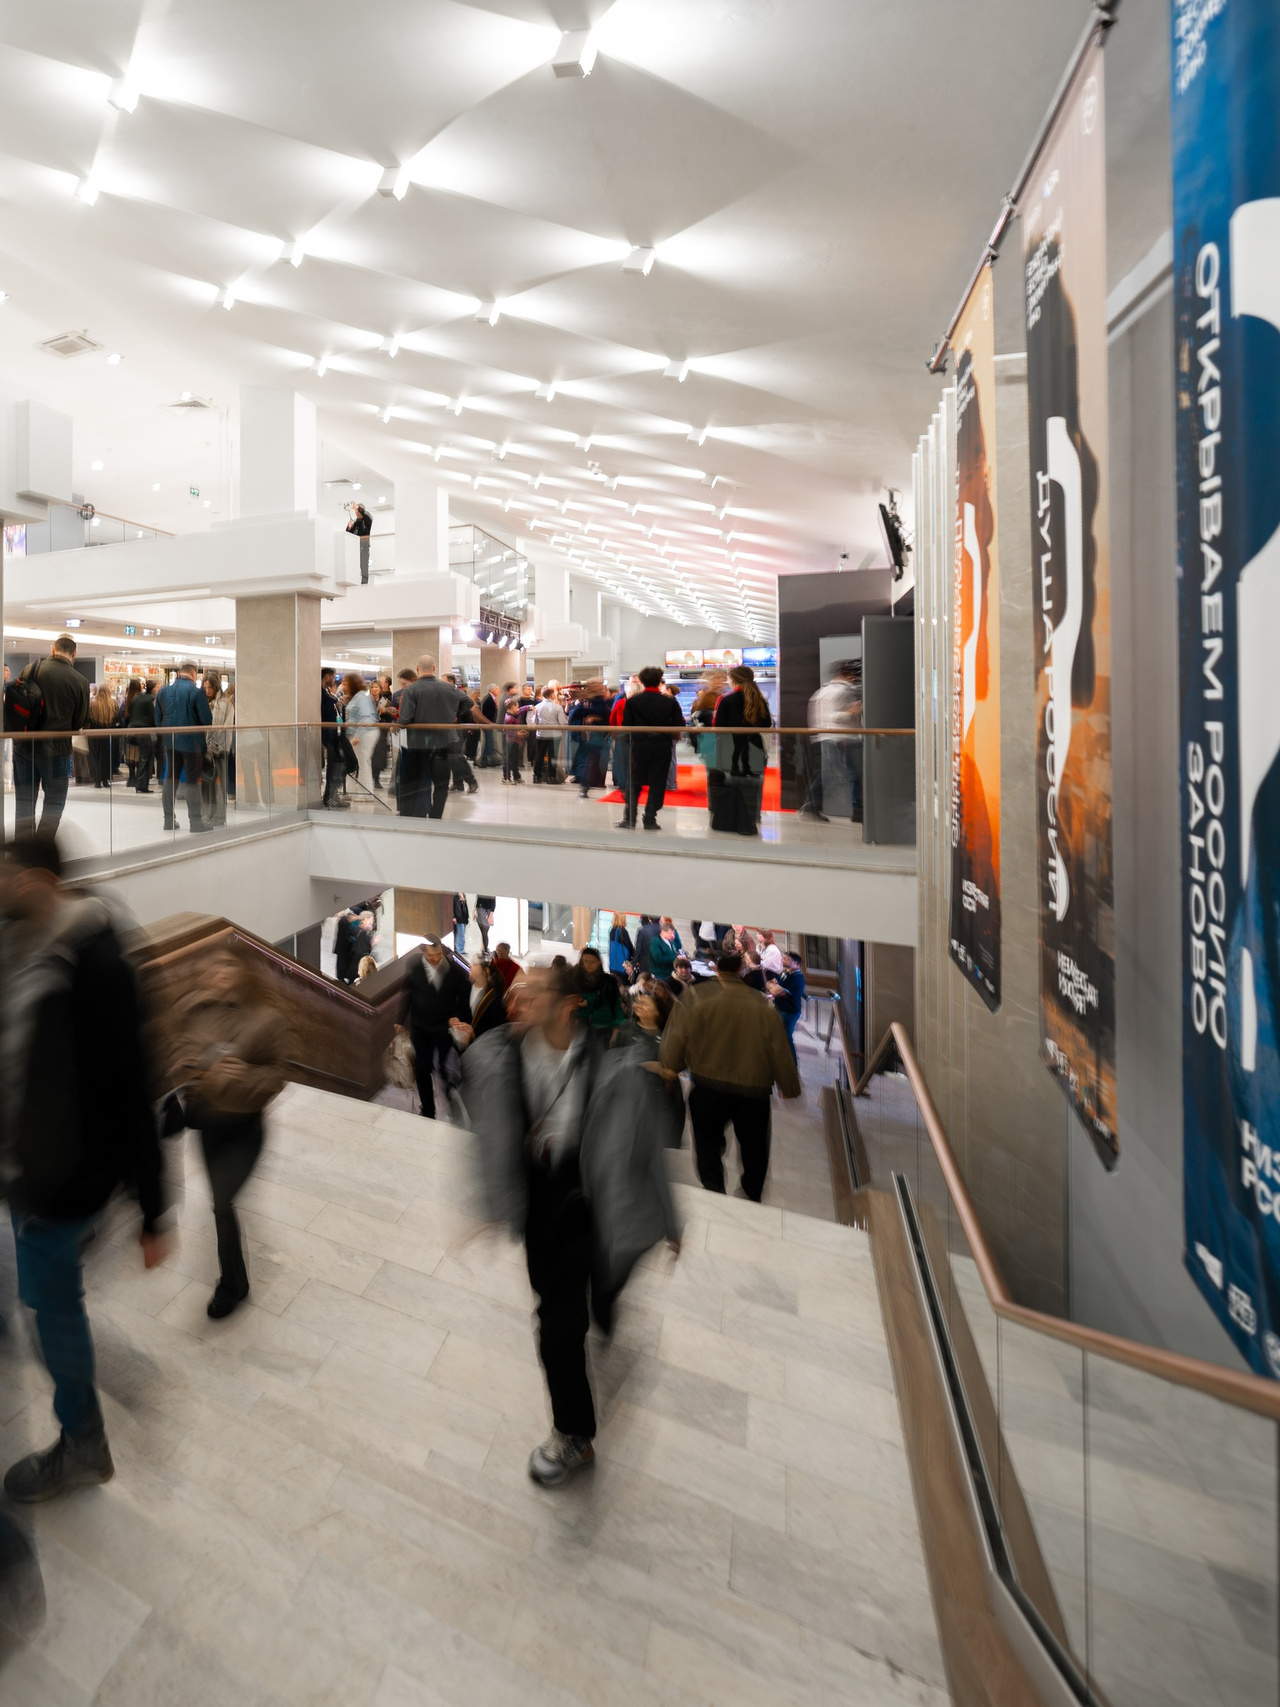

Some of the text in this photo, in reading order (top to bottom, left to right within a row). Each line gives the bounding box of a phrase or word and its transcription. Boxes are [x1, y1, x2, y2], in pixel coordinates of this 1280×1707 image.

[1035, 470, 1054, 655] ДУША
[1194, 241, 1228, 1050] ОТКРЫВАЕМ РОССИЮ
[1187, 740, 1208, 1035] ЗАНОВО
